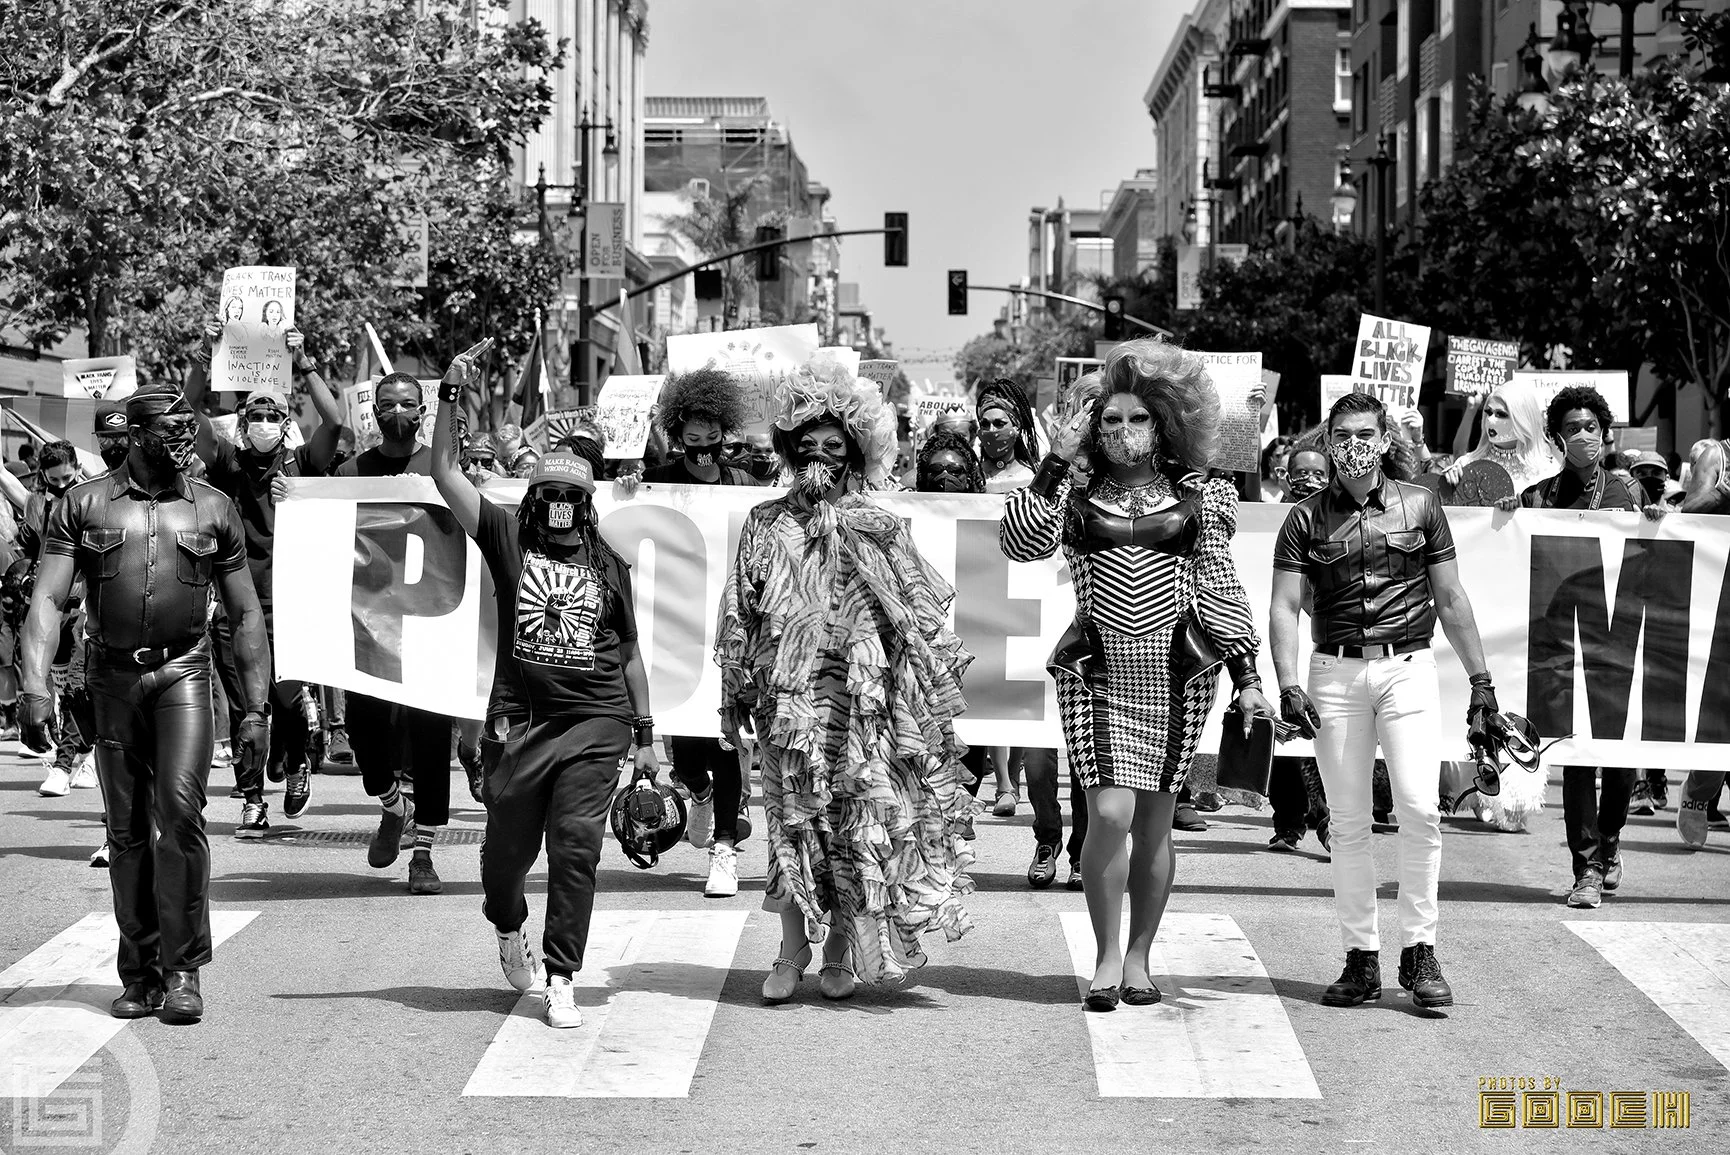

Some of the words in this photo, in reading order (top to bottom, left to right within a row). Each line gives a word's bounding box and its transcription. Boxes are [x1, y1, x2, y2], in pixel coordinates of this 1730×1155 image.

[612, 209, 622, 266] BUSINESS
[591, 233, 600, 266] OPEN
[602, 247, 610, 266] FOR
[225, 272, 253, 286] BLACK
[260, 271, 293, 282] TRANS
[248, 285, 292, 298] MATTER
[1372, 321, 1412, 341] ALL
[1486, 343, 1518, 357] AGENDA
[228, 360, 280, 370] INACTION
[1203, 355, 1232, 365] STICE
[1236, 354, 1258, 365] FOR
[1455, 355, 1486, 367] ARREST
[1488, 359, 1506, 369] THE
[1360, 361, 1412, 384] LIVES
[1455, 365, 1478, 374] COPS
[1482, 367, 1507, 377] THAT
[228, 376, 279, 386] VIOLENCE
[1455, 372, 1506, 385] MURDERED
[1532, 379, 1560, 388] There
[565, 459, 588, 474] RACISM
[570, 468, 587, 480] AGAIN
[550, 510, 572, 520] LIVES
[549, 520, 572, 528] MATTER
